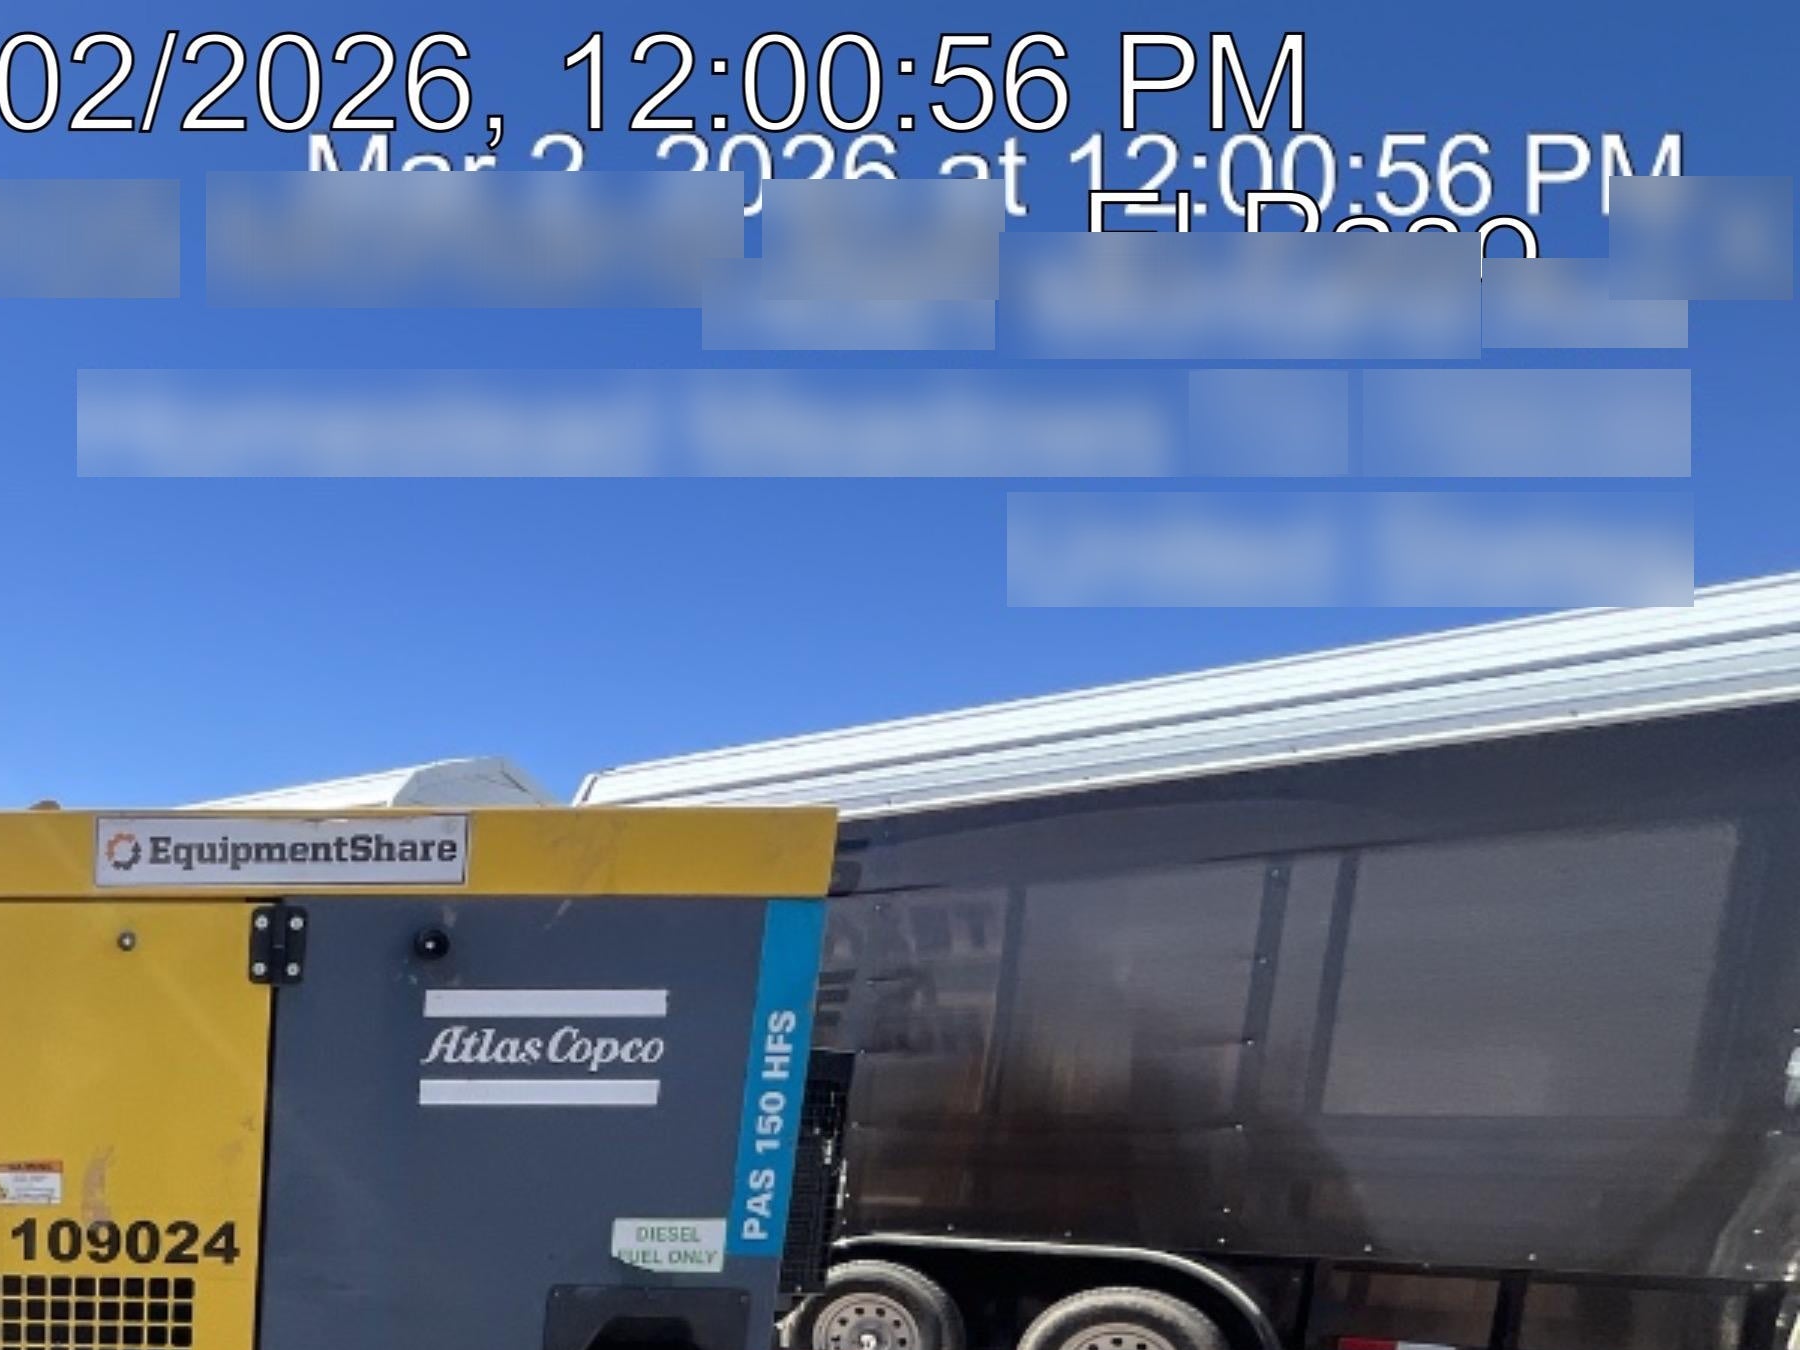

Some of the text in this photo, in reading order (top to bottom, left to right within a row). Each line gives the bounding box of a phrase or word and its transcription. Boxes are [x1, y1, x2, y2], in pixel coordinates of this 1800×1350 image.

[149, 834, 457, 871] EquipmentShare
[741, 1009, 797, 1241] PAS 150 HFS
[11, 1217, 240, 1264] 109024
[636, 1226, 701, 1243] DIESEL
[668, 1250, 718, 1265] ONLY
